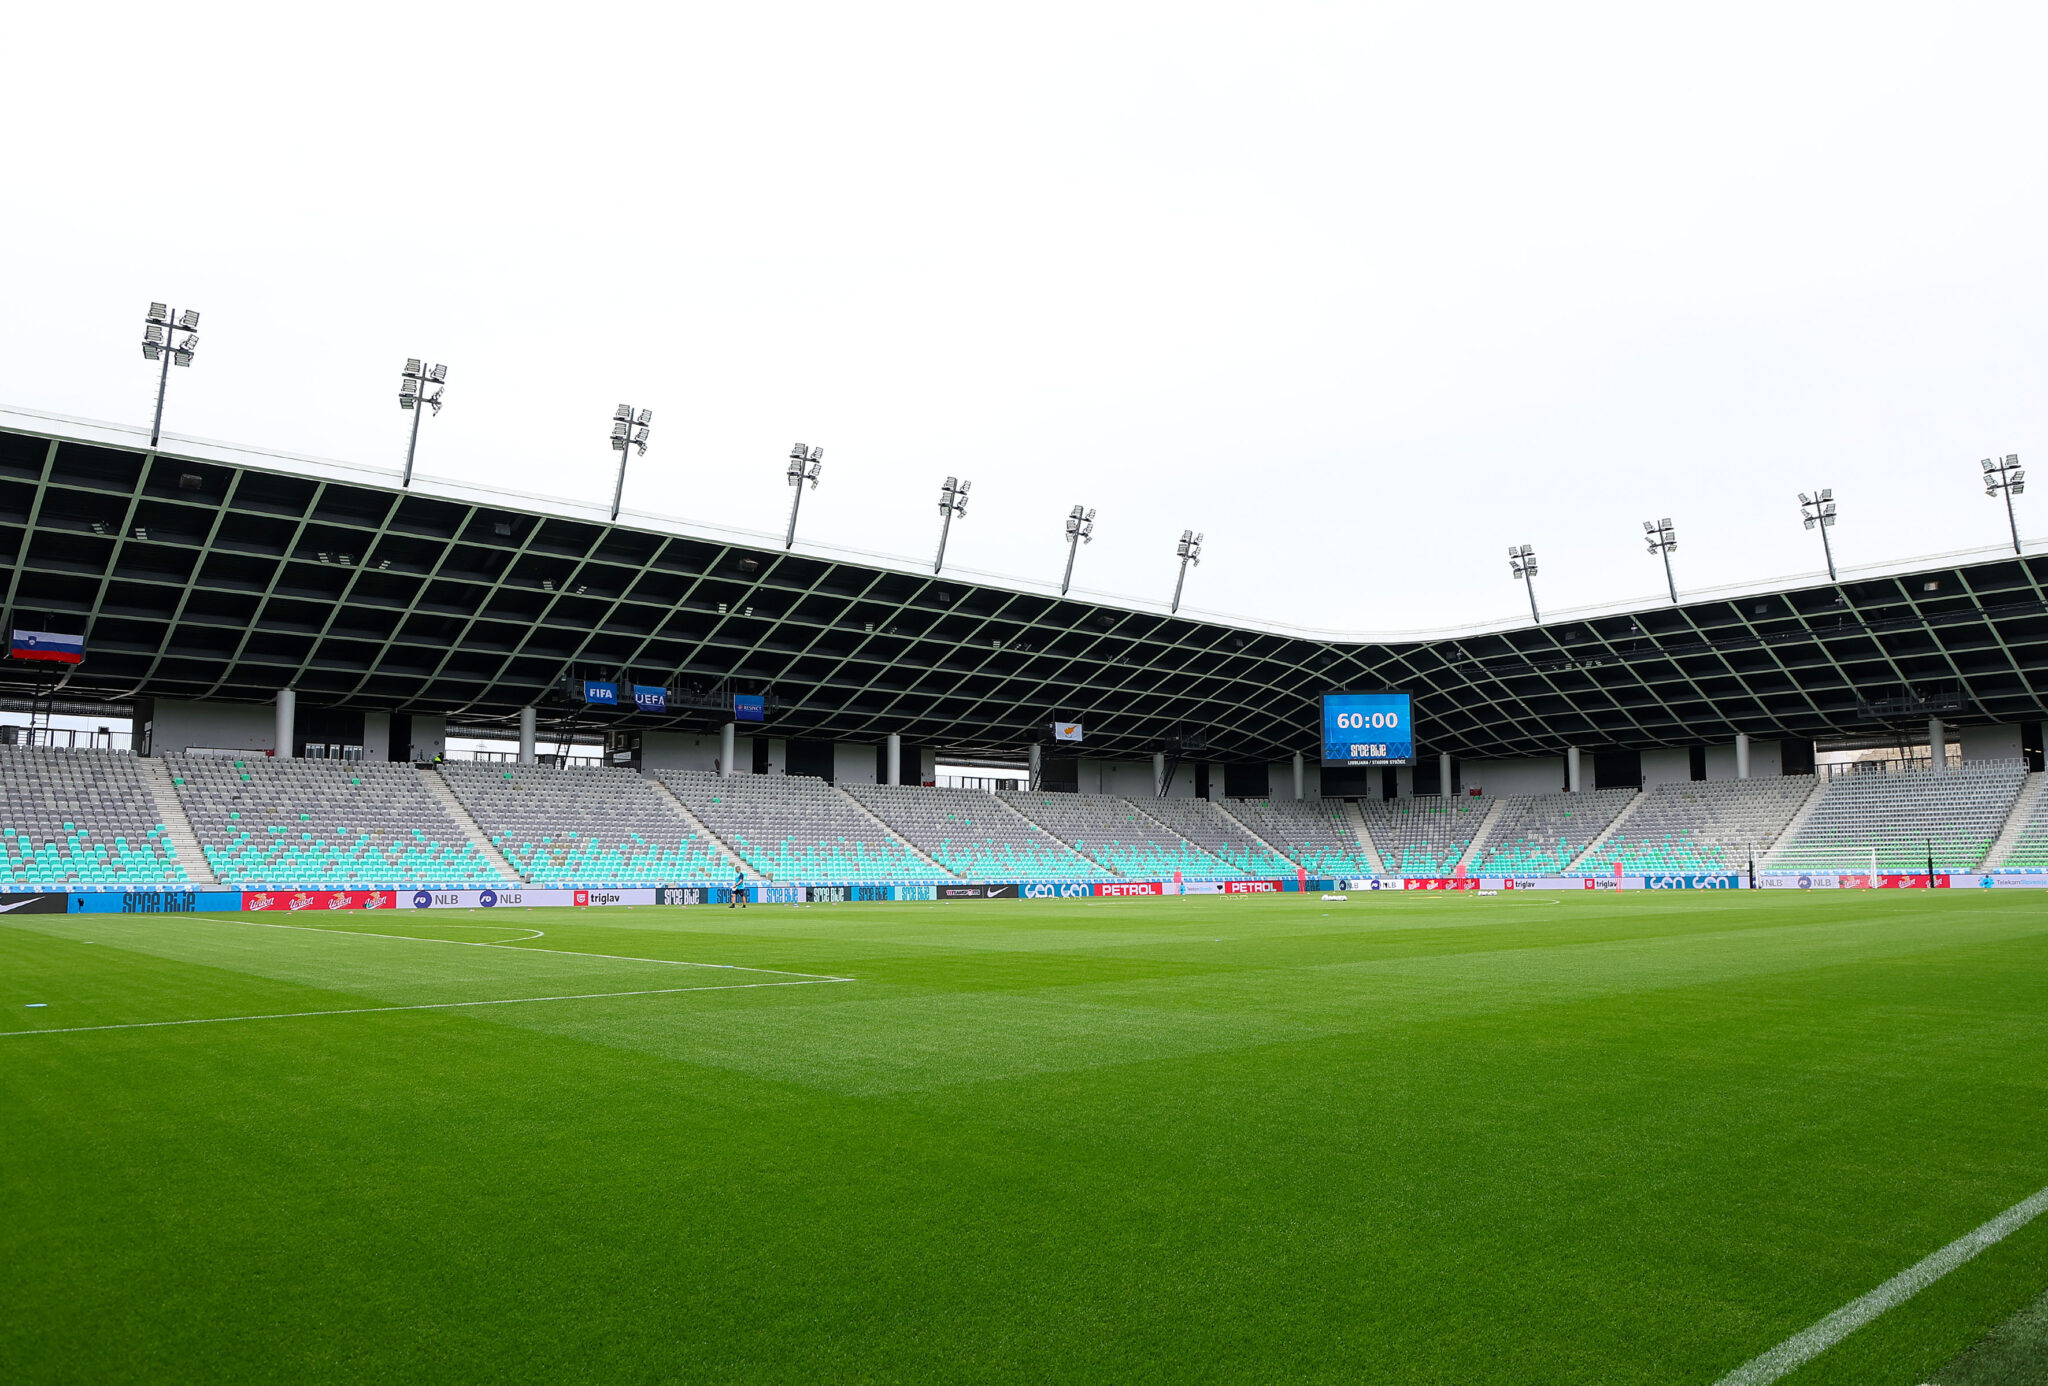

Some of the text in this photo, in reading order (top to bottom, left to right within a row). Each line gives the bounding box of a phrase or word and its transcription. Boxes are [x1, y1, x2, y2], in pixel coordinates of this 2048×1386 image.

[589, 688, 613, 699] FIFA
[635, 693, 665, 706] UEFA
[1337, 712, 1398, 729] 60:00
[1231, 882, 1277, 893] PETROL
[1515, 879, 1535, 889] triglav
[1765, 879, 1783, 887] NLB
[1813, 879, 1831, 887] NLB
[1102, 884, 1156, 896] PETROL
[249, 897, 275, 911] Union
[289, 896, 314, 911] Union
[328, 896, 352, 910] Union
[434, 894, 459, 905] NLB
[500, 894, 522, 904] NLB
[590, 892, 620, 905] triglav
